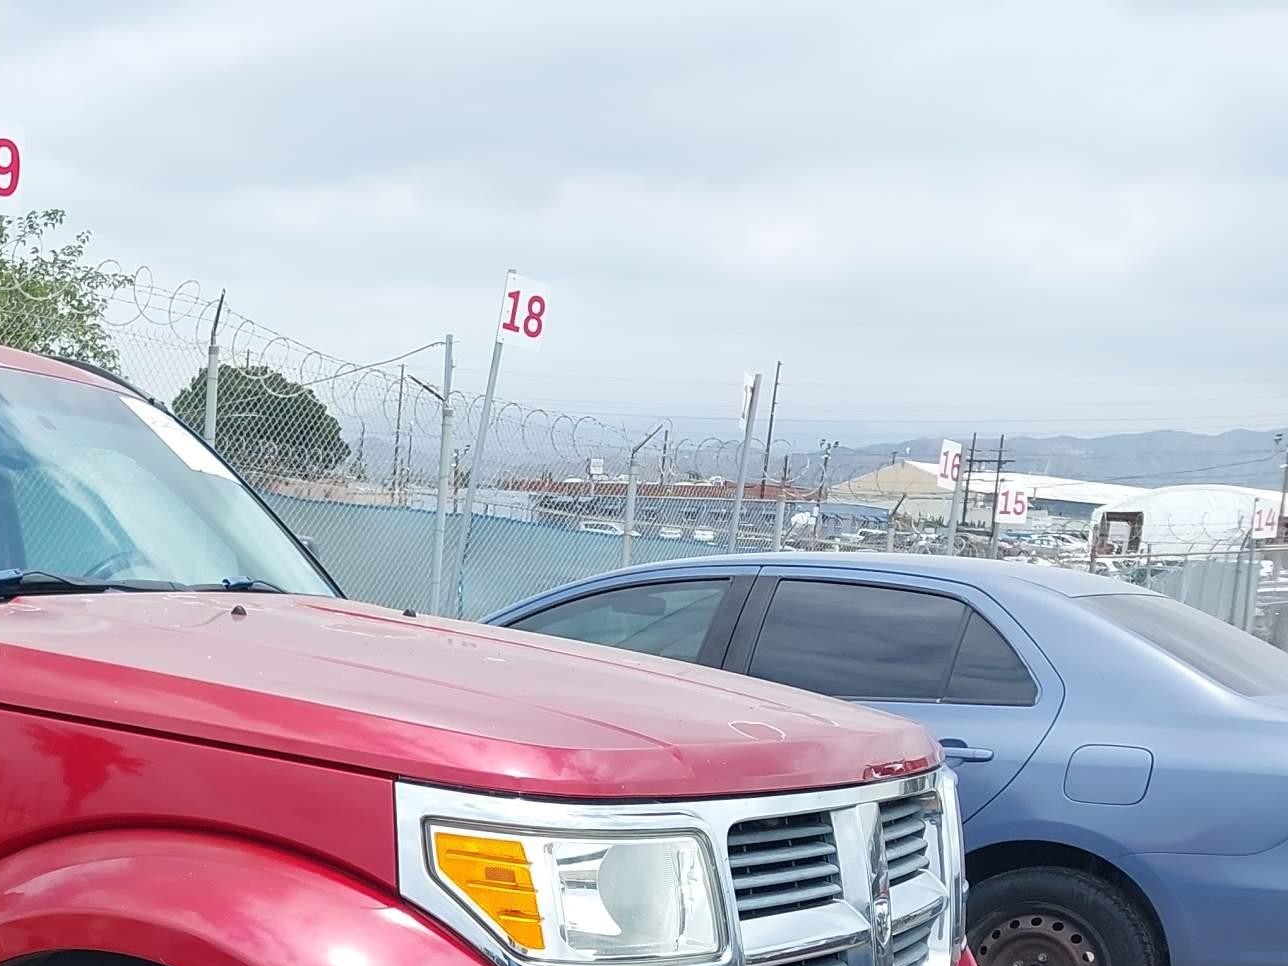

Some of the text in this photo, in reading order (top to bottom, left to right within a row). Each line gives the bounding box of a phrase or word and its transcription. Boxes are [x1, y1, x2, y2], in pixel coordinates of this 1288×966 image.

[502, 290, 545, 338] 18
[940, 450, 962, 482] 16
[999, 490, 1026, 516] 15
[1255, 508, 1277, 532] 14
